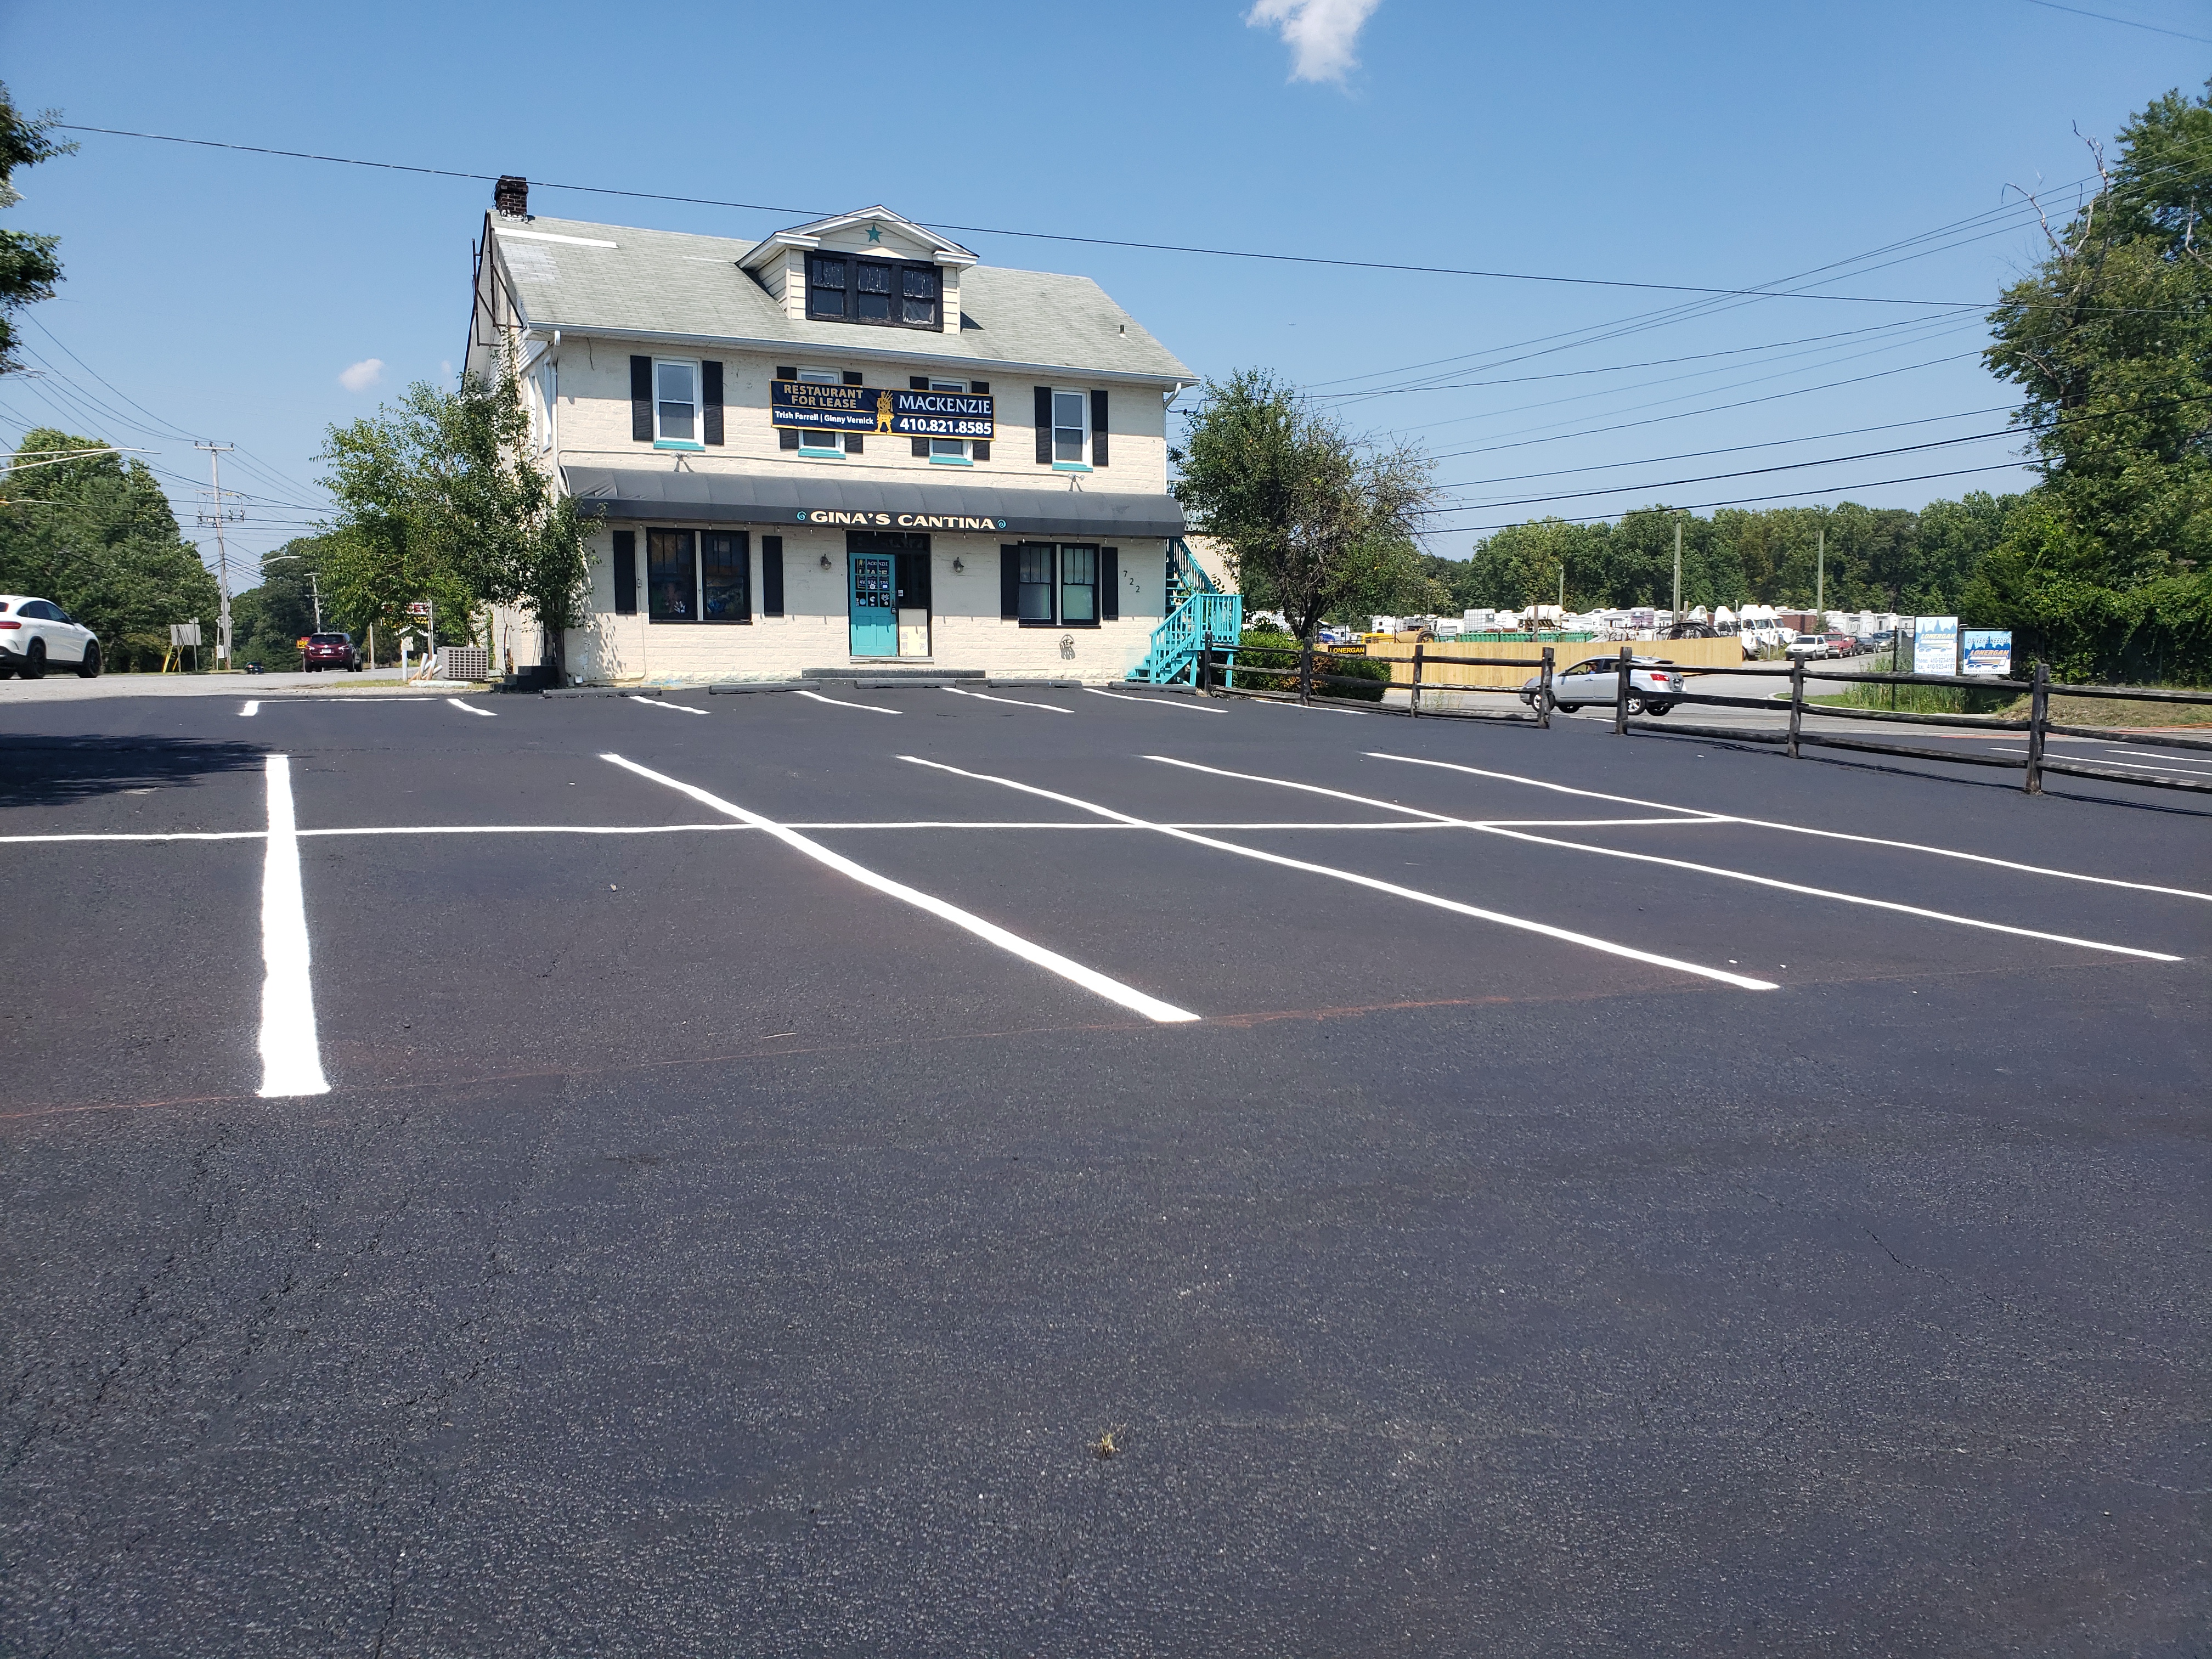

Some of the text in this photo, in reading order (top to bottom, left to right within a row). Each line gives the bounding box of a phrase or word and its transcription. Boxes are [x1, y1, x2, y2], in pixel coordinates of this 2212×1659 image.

[784, 384, 863, 399] RESTAURANT
[792, 395, 857, 409] FOR LEASE
[899, 395, 991, 414] MACKENZIE
[775, 410, 793, 419] Trish
[795, 412, 819, 421] Farrell
[824, 415, 845, 425] Ginny
[847, 416, 874, 425] Vernick
[900, 418, 992, 435] 410.821.8585
[810, 511, 996, 529] GINA'S CANTINA
